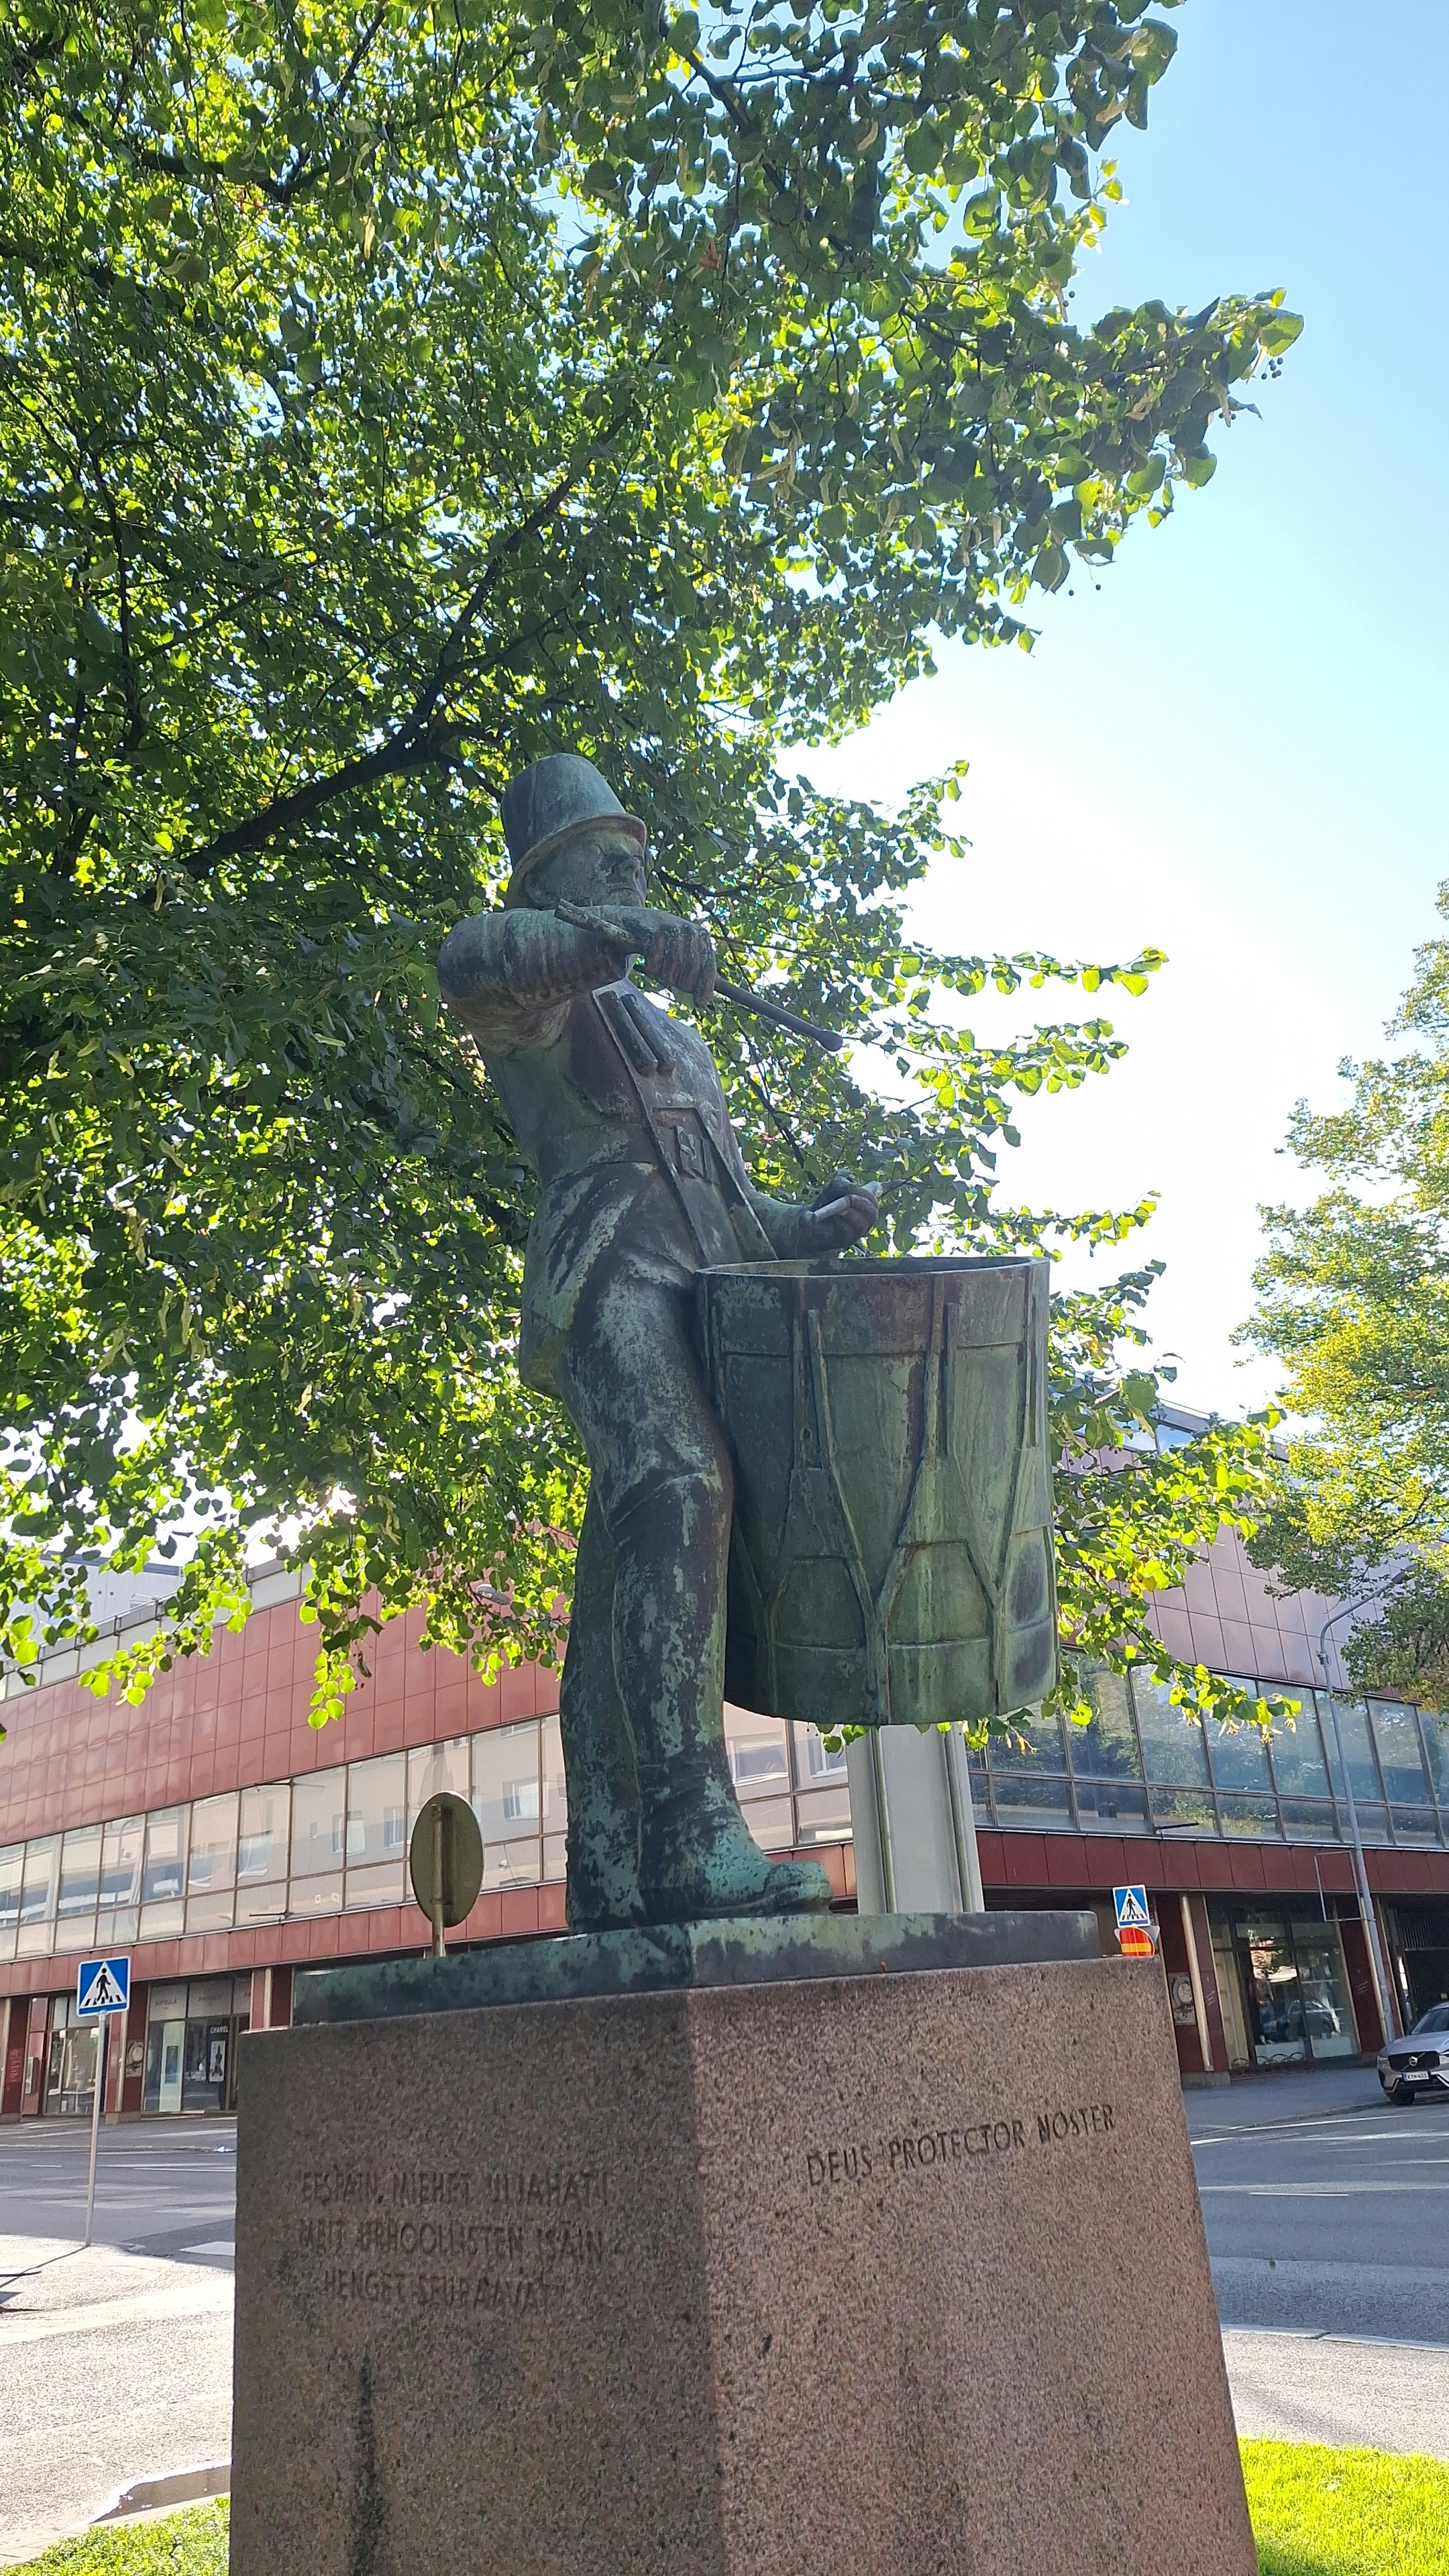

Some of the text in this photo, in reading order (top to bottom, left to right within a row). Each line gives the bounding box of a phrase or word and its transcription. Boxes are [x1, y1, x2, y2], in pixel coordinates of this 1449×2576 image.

[210, 2025, 229, 2033] CHANEL
[806, 2103, 1115, 2186] DEUS PROTECTOR NOSTER
